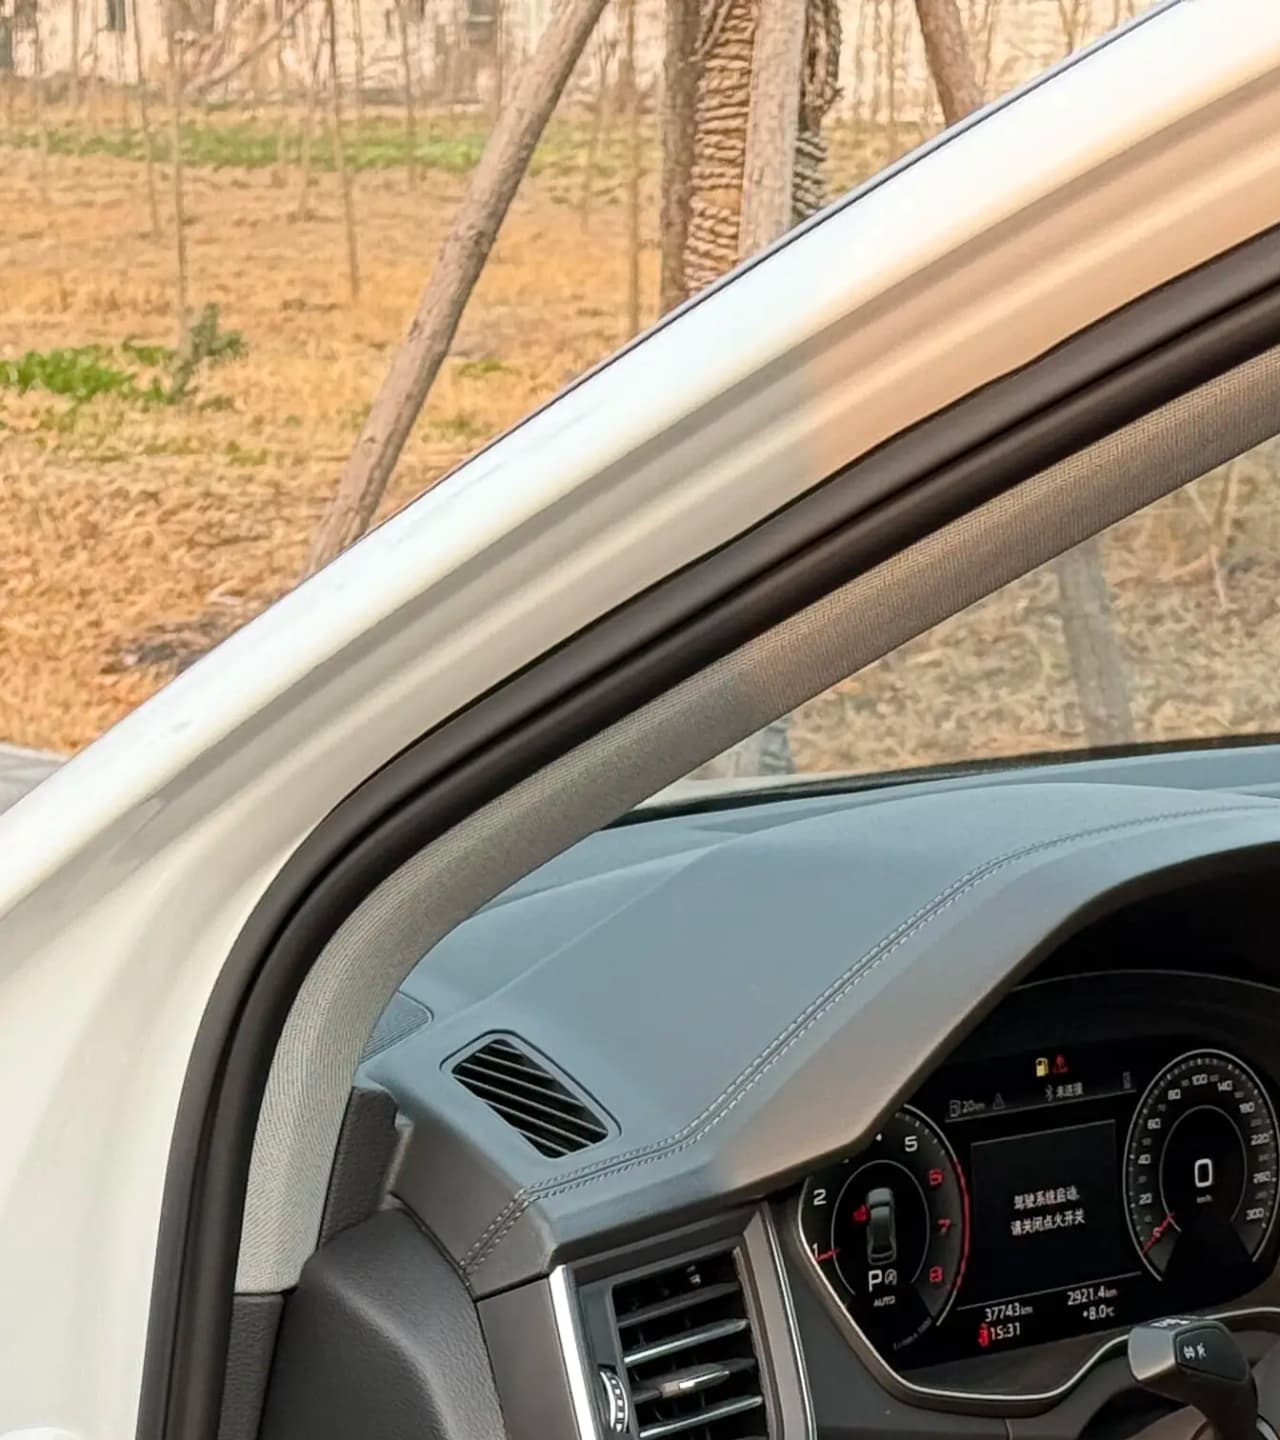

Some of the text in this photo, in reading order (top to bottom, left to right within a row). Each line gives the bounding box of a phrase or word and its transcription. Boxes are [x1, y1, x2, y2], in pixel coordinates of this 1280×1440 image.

[904, 1135, 918, 1152] 5
[1194, 1158, 1213, 1188] 0
[812, 1188, 827, 1206] 2
[868, 1269, 883, 1293] P
[990, 1321, 1021, 1341] 15:31
